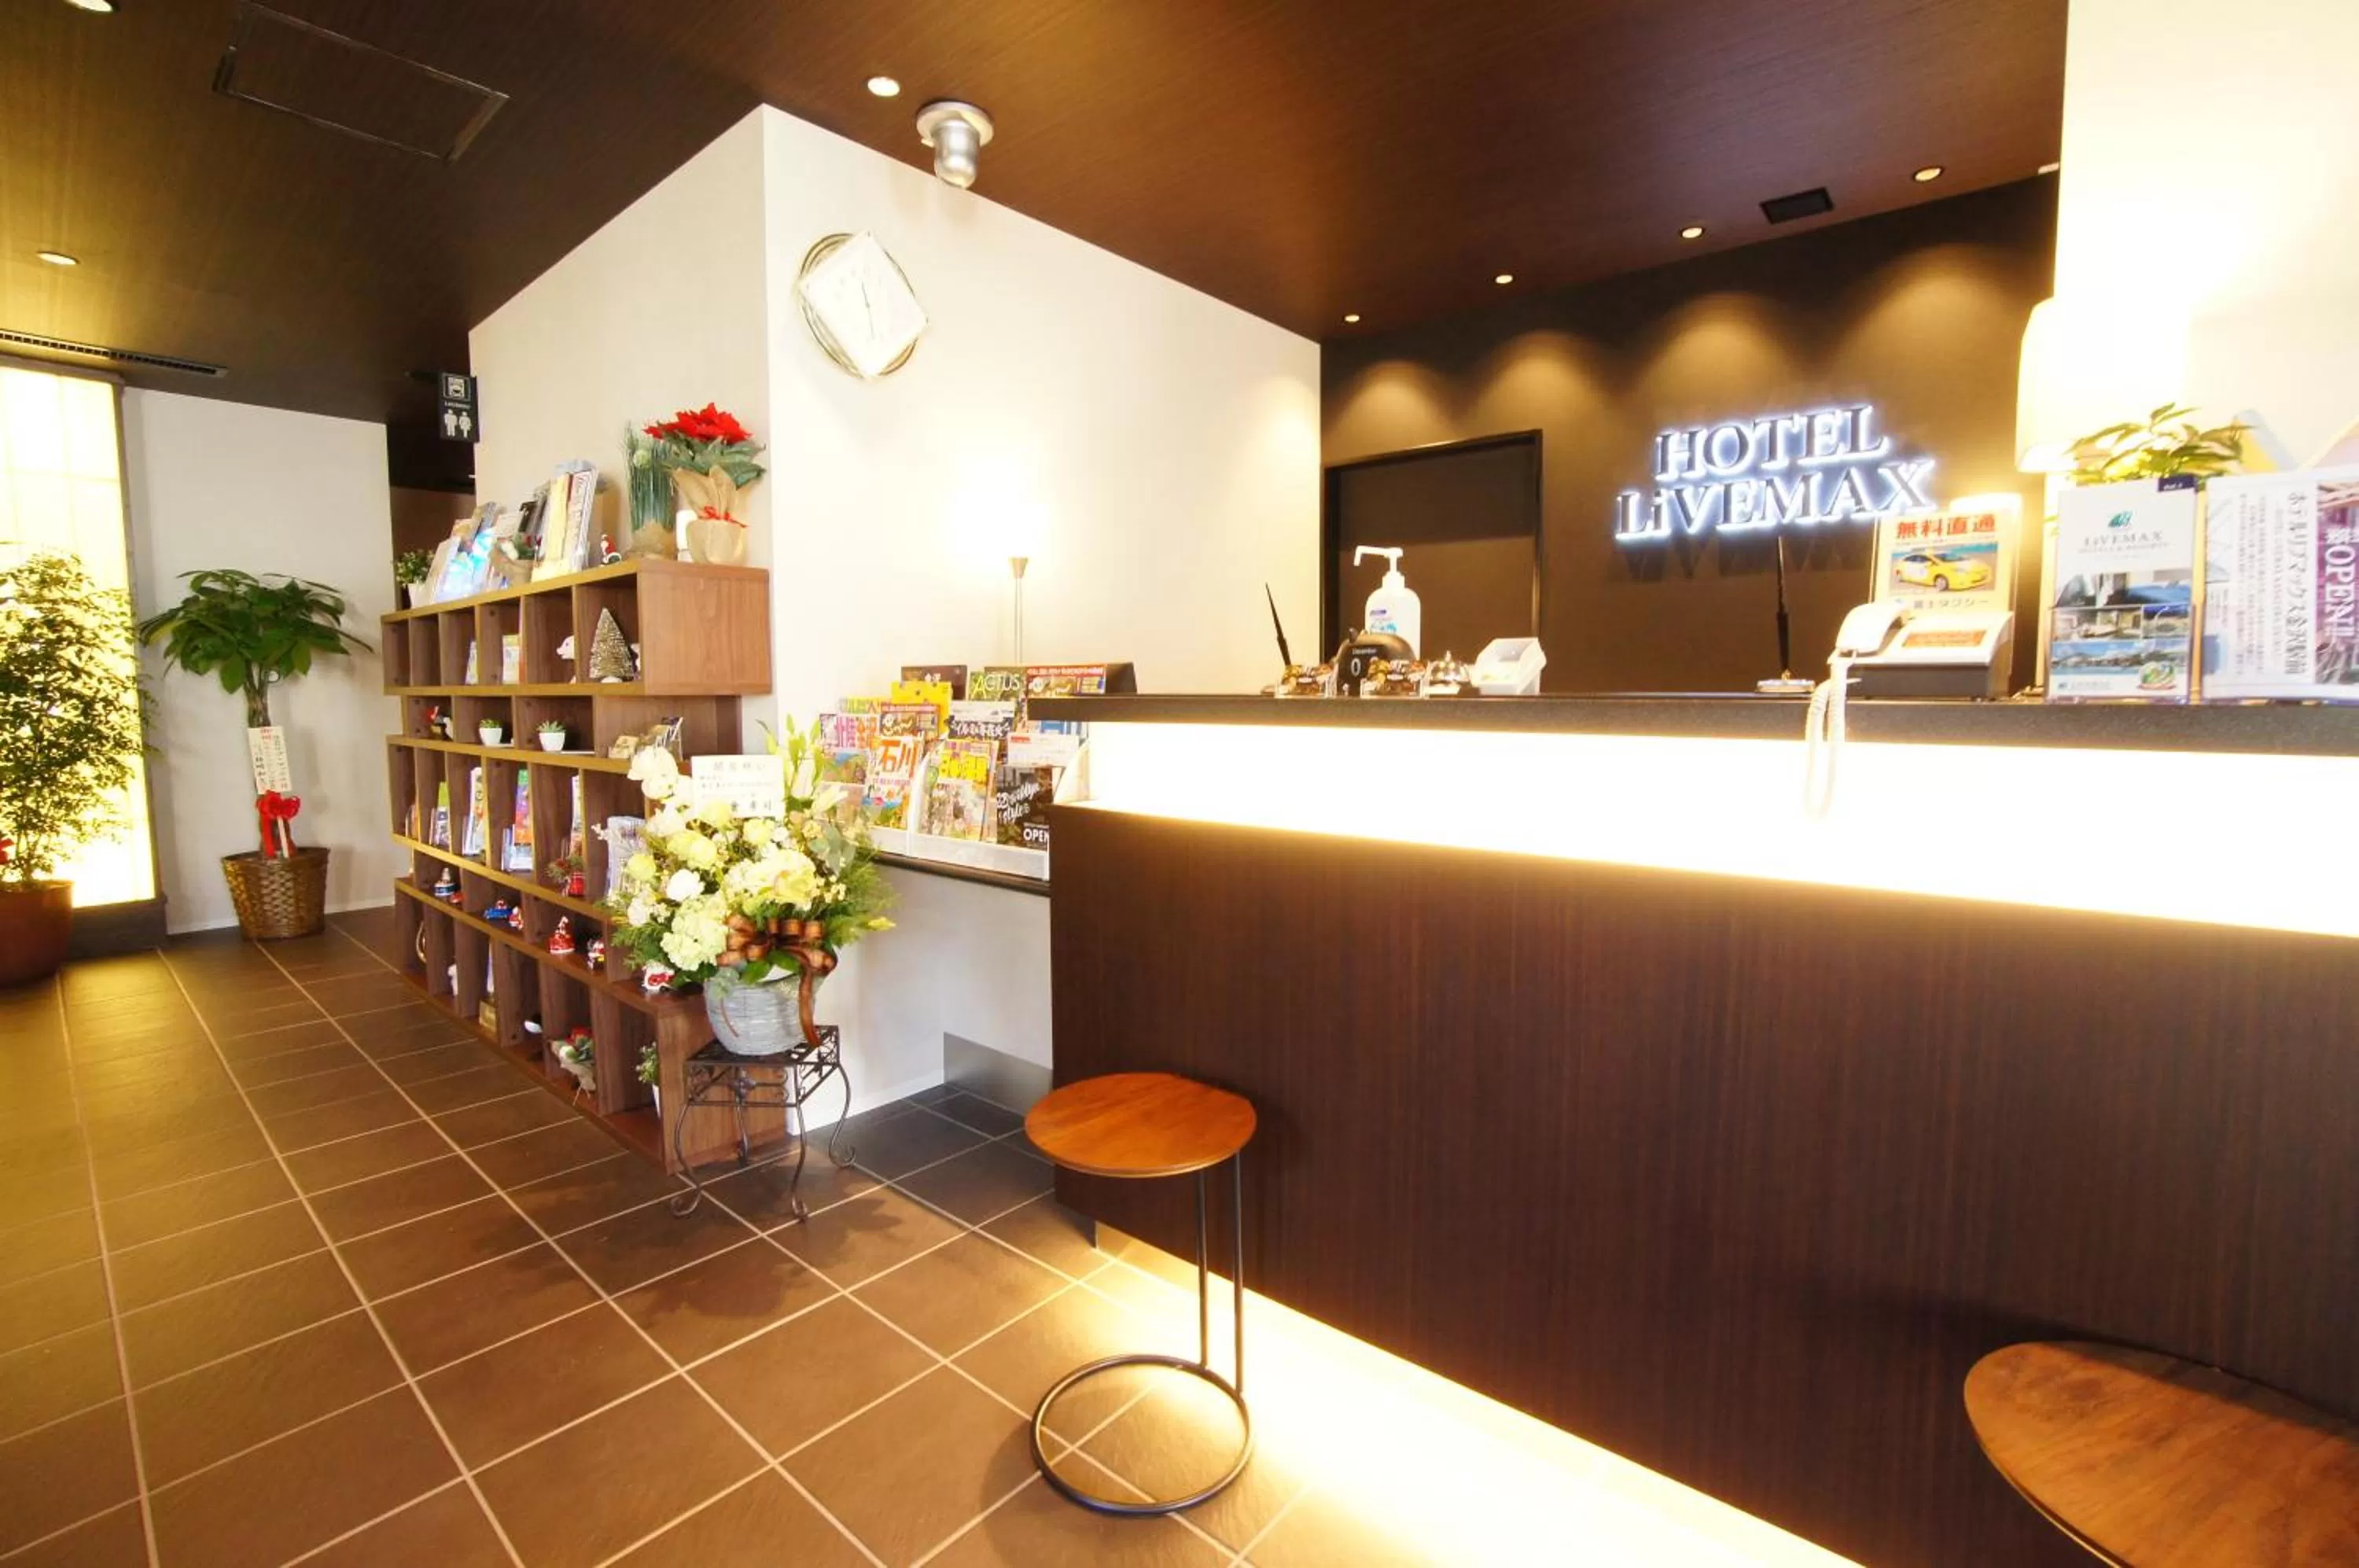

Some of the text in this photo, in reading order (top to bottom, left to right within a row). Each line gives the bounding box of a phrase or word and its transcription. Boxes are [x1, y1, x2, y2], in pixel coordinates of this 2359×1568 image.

[1655, 404, 1889, 480] HOTEL
[1614, 460, 1937, 539] LiVEMAX
[1896, 513, 1996, 539] 無料直通
[880, 738, 918, 780] 石川
